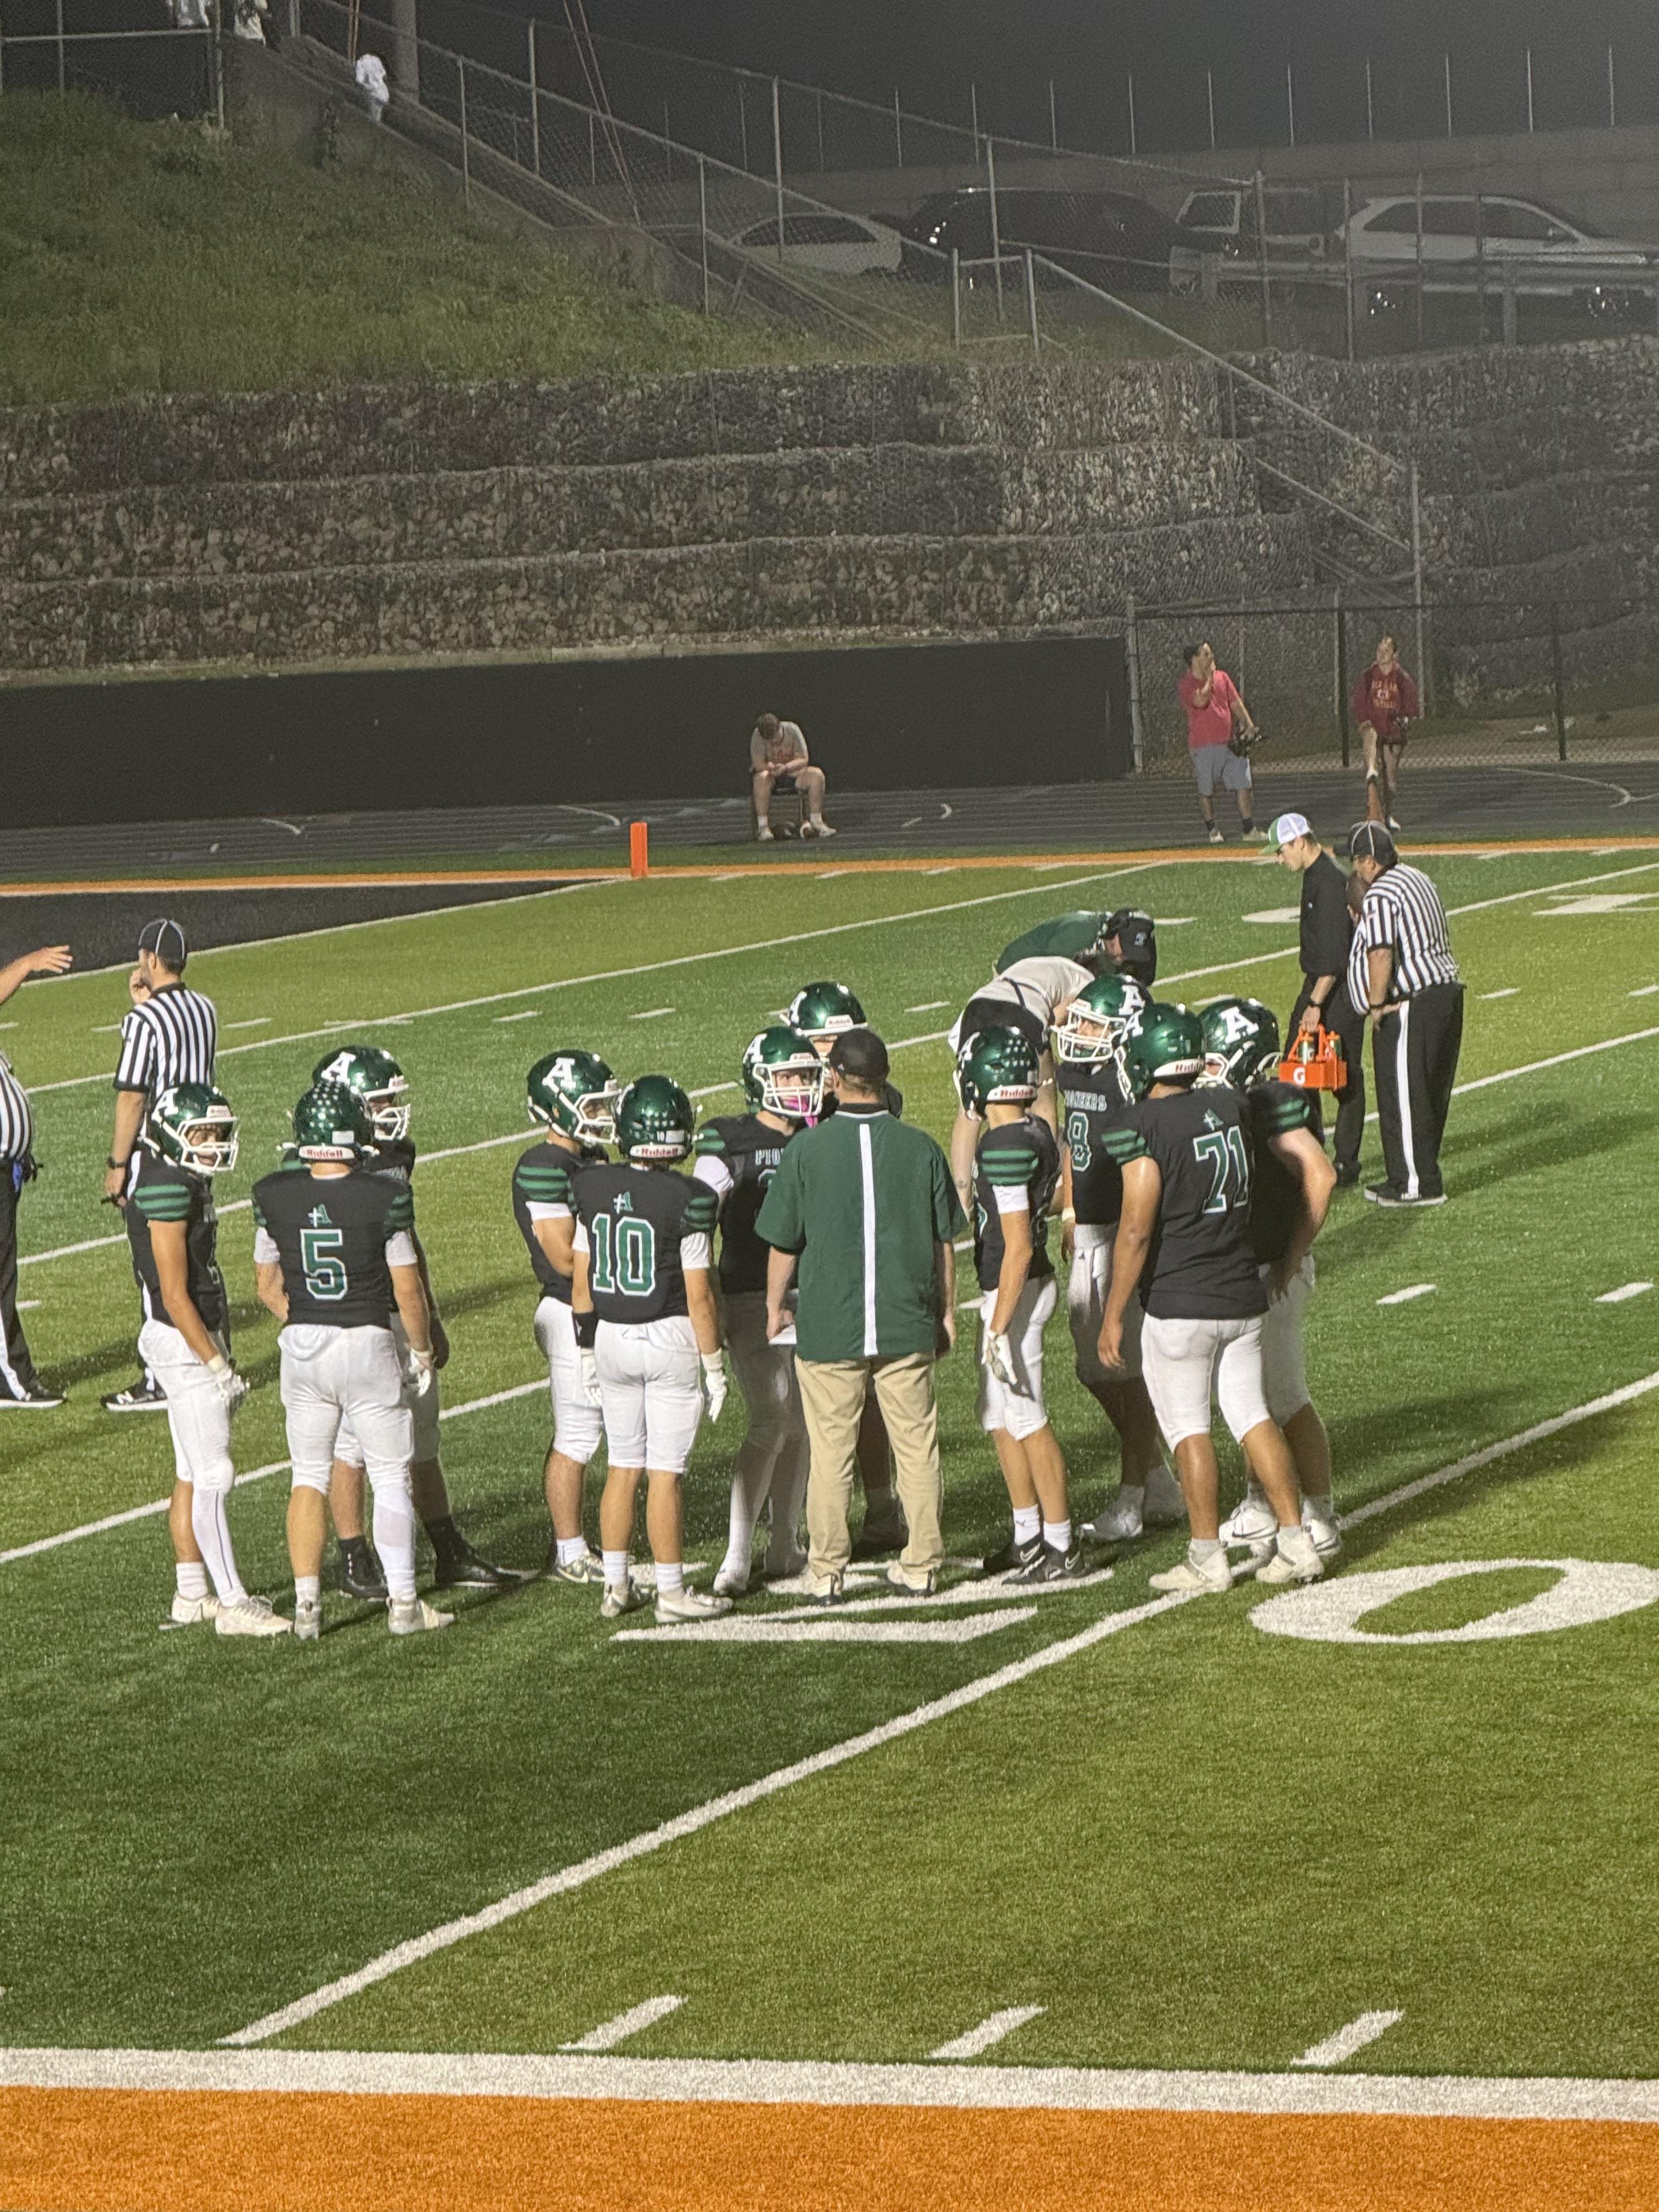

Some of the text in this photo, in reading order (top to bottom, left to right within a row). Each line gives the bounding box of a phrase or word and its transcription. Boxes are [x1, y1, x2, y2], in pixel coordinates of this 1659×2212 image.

[1119, 984, 1146, 1015] A
[1220, 1005, 1259, 1043] A
[742, 1032, 768, 1064] A
[321, 1051, 357, 1085] A
[543, 1057, 577, 1090] A
[1293, 1066, 1306, 1085] G
[306, 1149, 343, 1159] Riddell
[754, 1147, 785, 1166] PIO
[1067, 1111, 1092, 1172] 8
[1193, 1125, 1249, 1215] 71
[300, 1228, 348, 1300] 5
[591, 1212, 656, 1297] 10
[1247, 1557, 1659, 1645] 0
